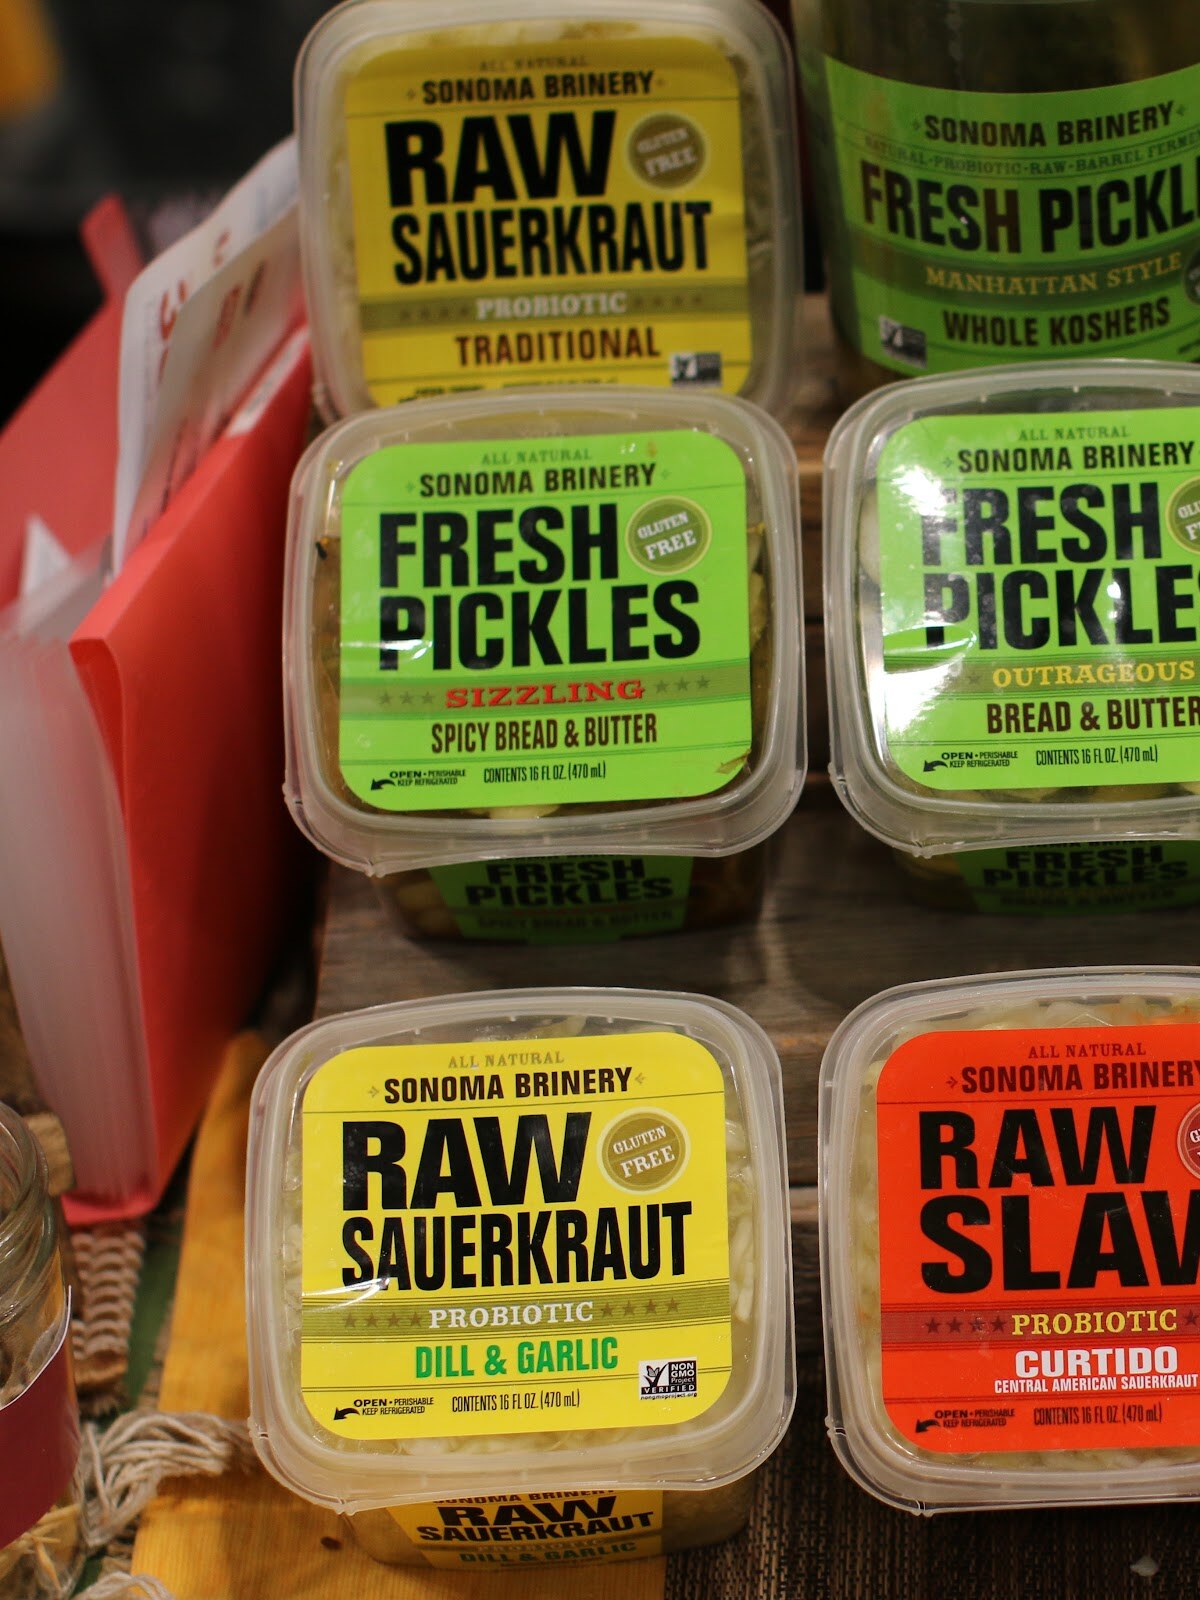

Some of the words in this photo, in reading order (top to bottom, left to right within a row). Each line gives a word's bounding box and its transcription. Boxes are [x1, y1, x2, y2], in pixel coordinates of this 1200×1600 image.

[423, 78, 534, 104] SONOMA
[545, 71, 655, 96] BRINERY
[924, 115, 1047, 147] SONOMA
[1057, 101, 1175, 145] BRINERY
[384, 111, 617, 208] RAW
[645, 150, 697, 176] FREE
[860, 160, 1021, 254] FRESH
[391, 201, 712, 285] SAUERKRAUT
[926, 266, 1099, 296] MANHATTAN
[1107, 252, 1183, 288] STYLE
[476, 292, 627, 319] PROBIOTIC
[943, 310, 1039, 347] WHOLE
[1049, 299, 1171, 344] KOSHERS
[456, 327, 661, 366] TRADITIONAL
[1018, 428, 1048, 440] ALL
[1054, 426, 1129, 439] NATURAL
[481, 453, 510, 465] ALL
[517, 449, 592, 464] NATURAL
[958, 447, 1071, 473] SONOMA
[1083, 441, 1195, 469] BRINERY
[420, 470, 533, 497] SONOMA
[545, 463, 656, 492] BRINERY
[638, 511, 689, 540] GLUTEN
[920, 482, 1162, 566] FRESH
[379, 503, 619, 588] FRESH
[644, 530, 696, 561] FREE
[378, 580, 701, 671] PICKLES
[993, 660, 1196, 688] OUTRAGEOUS
[445, 679, 645, 709] SIZZLING
[987, 702, 1071, 734] BREAD
[1080, 702, 1100, 730] &
[431, 722, 490, 754] SPICY
[495, 719, 559, 752] BREAD
[564, 720, 579, 747] &
[584, 713, 657, 747] BUTTER
[941, 752, 973, 760] OPEN
[979, 751, 1018, 759] PERISHABLE
[967, 759, 1010, 767] REFRIGERATED
[1036, 750, 1079, 765] CONTENTS
[1082, 749, 1090, 764] 16
[1094, 749, 1103, 763] FL
[1120, 746, 1140, 764] (470
[486, 859, 645, 884] FRESH
[465, 877, 673, 906] PICKLES
[448, 1054, 477, 1069] ALL
[485, 1051, 564, 1067] NATURAL
[1028, 1046, 1059, 1059] ALL
[1066, 1043, 1146, 1057] NATURAL
[384, 1074, 504, 1103] SONOMA
[515, 1067, 632, 1098] BRINERY
[961, 1065, 1082, 1094] SONOMA
[612, 1125, 667, 1154] GLUTEN
[919, 1106, 1156, 1190] RAW
[342, 1112, 592, 1210] RAW
[620, 1145, 675, 1178] FREE
[342, 1201, 692, 1291] SAUERKRAUT
[428, 1301, 595, 1329] PROBIOTIC
[1012, 1309, 1177, 1336] PROBIOTIC
[415, 1345, 474, 1379] DILL
[484, 1345, 506, 1374] &
[517, 1336, 619, 1373] GARLIC
[1015, 1346, 1178, 1378] CURTIDO
[644, 1385, 694, 1393] VERIFIED
[994, 1377, 1049, 1394] CENTRAL
[1052, 1376, 1117, 1392] AMERICAN
[1121, 1374, 1199, 1390] SAUERKRAUT
[354, 1399, 387, 1407] OPEN
[394, 1397, 434, 1406] PERISHABLE
[380, 1406, 425, 1415] REFRIGERATED
[452, 1396, 497, 1412] CONTENTS
[500, 1395, 509, 1410] 16
[512, 1394, 522, 1409] FL
[540, 1390, 561, 1410] (470
[564, 1389, 580, 1408] mL)
[1034, 1408, 1079, 1426] CONTENTS
[1082, 1407, 1091, 1424] 16
[1094, 1407, 1103, 1423] FL
[437, 1496, 617, 1526] RAW
[416, 1511, 654, 1542] SAUERKRAUT
[460, 1553, 514, 1563] DILL
[550, 1542, 637, 1559] GARLIC
